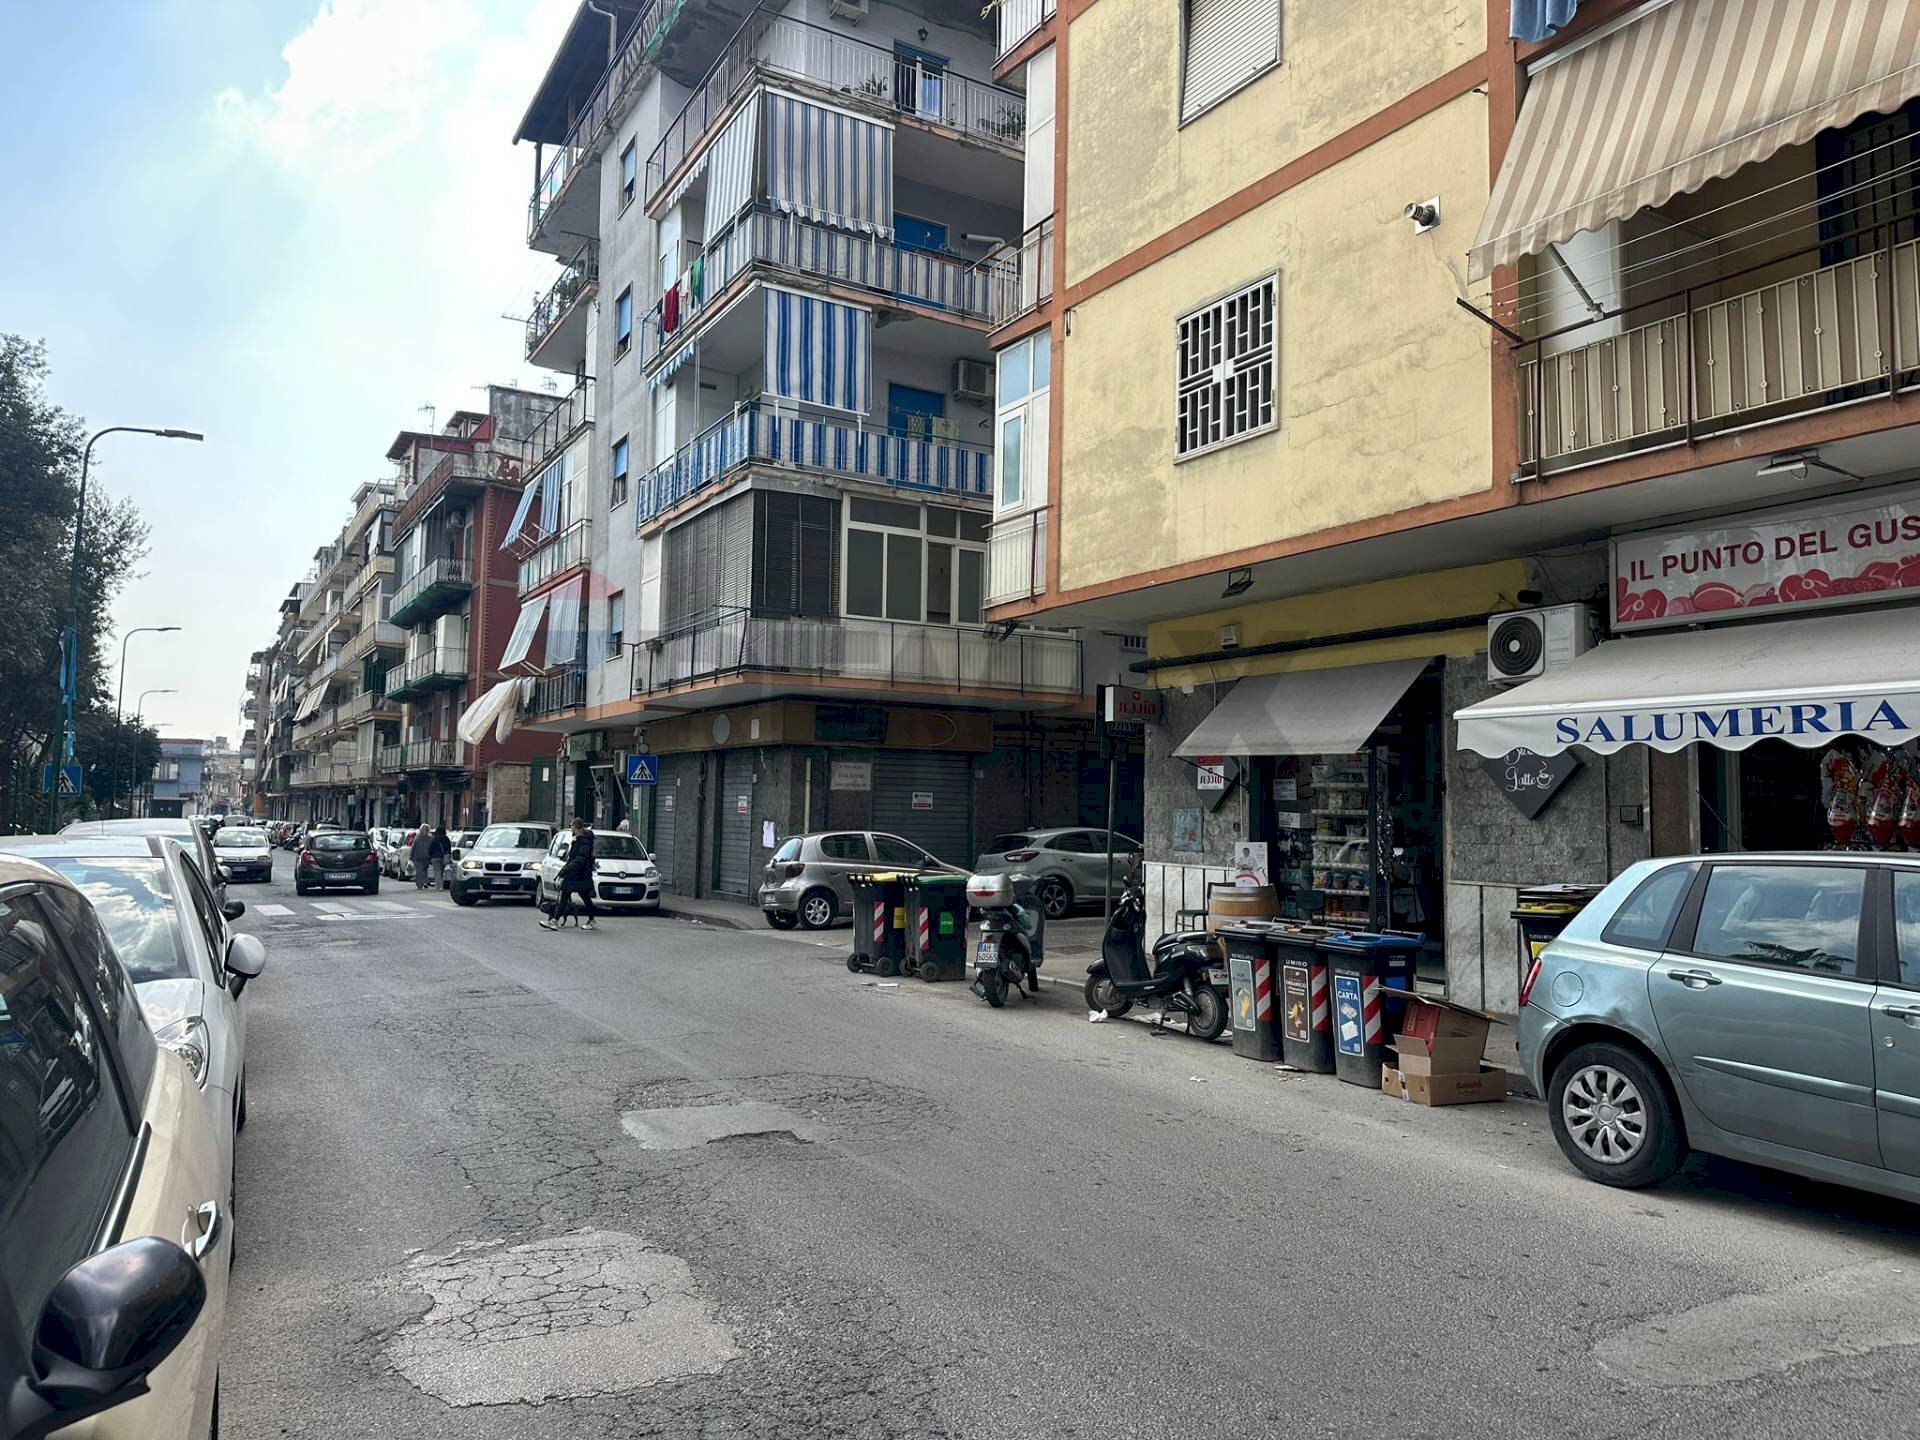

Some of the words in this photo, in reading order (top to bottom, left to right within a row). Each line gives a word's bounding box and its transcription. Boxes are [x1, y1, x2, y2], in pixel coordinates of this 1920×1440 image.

[1630, 560, 1653, 582] IL
[1662, 541, 1764, 578] PUNTO
[1775, 529, 1838, 559] DEL
[1847, 515, 1920, 549] GUS
[1556, 699, 1911, 744] SALUMERIA
[1338, 990, 1358, 1000] CARTA
